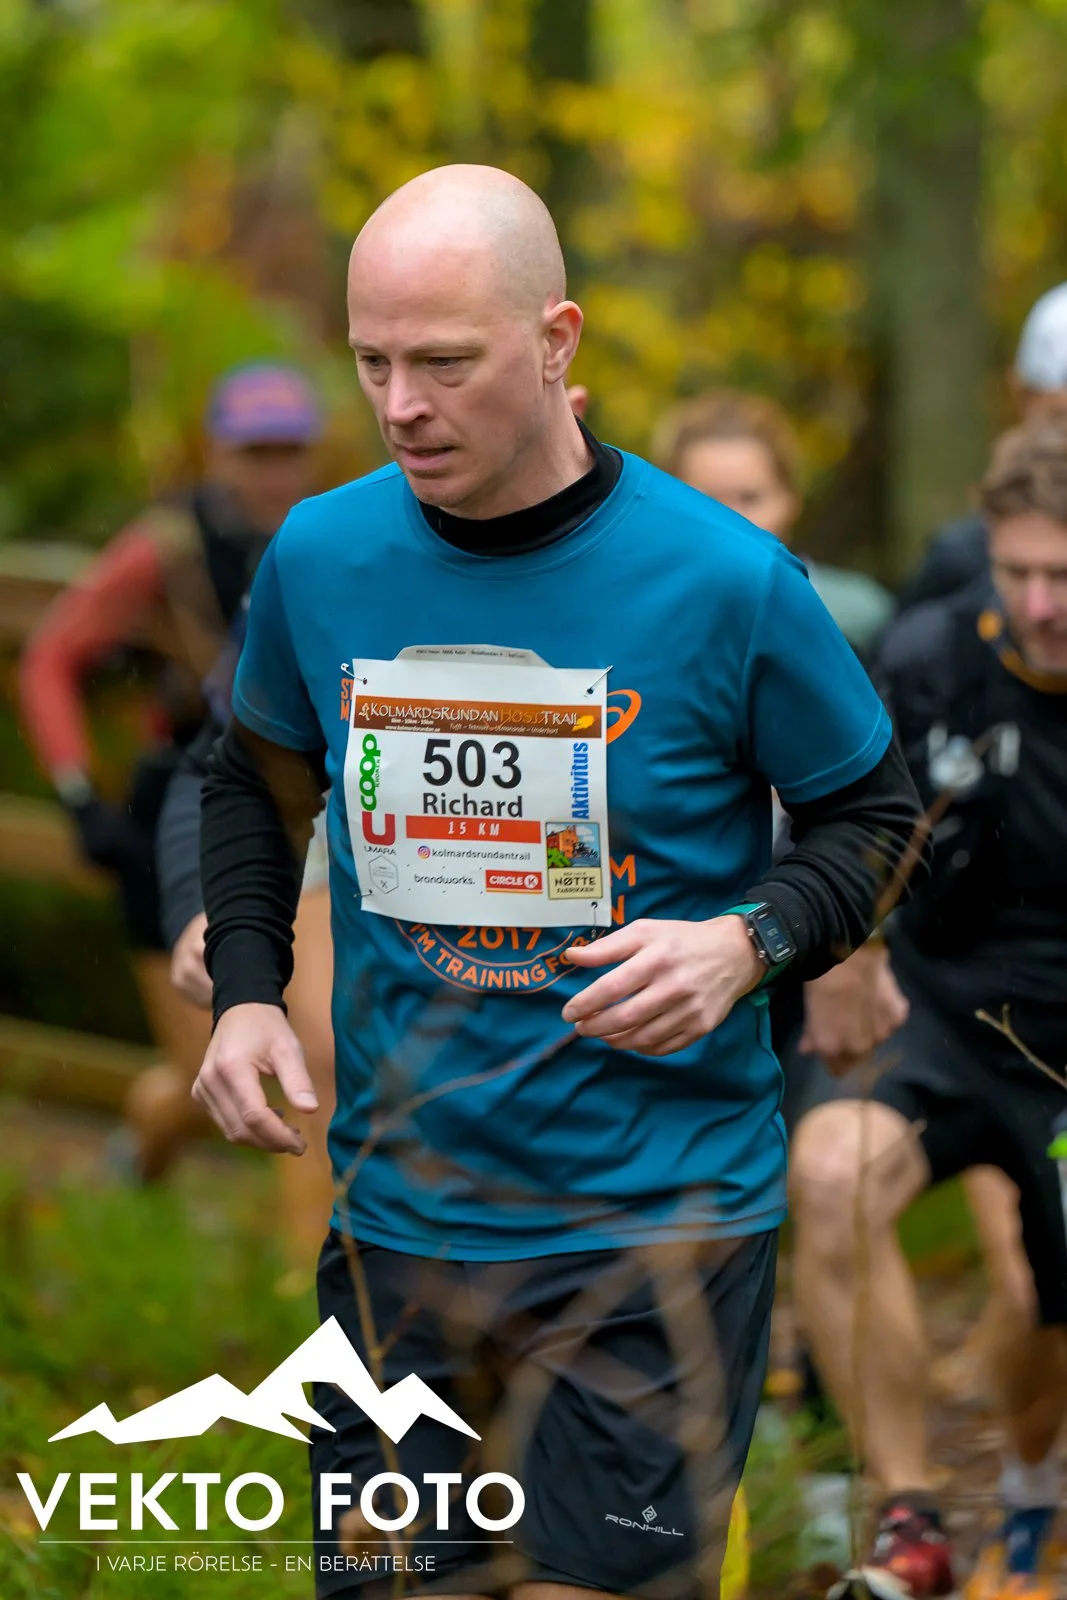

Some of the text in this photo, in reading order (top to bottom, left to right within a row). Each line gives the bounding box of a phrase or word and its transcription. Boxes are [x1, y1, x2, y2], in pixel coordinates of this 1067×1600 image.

[359, 734, 381, 811] coop
[423, 738, 522, 790] 503
[571, 742, 590, 819] Aktivitus
[423, 792, 523, 818] Richard
[448, 821, 500, 836] 15 KM
[364, 845, 397, 855] UMARA
[432, 849, 531, 861] kolmardsrundantrail
[489, 875, 523, 886] CIRCLE
[457, 926, 542, 950] 2017
[436, 947, 547, 988] TRAINING
[605, 1513, 684, 1537] RONHILL
